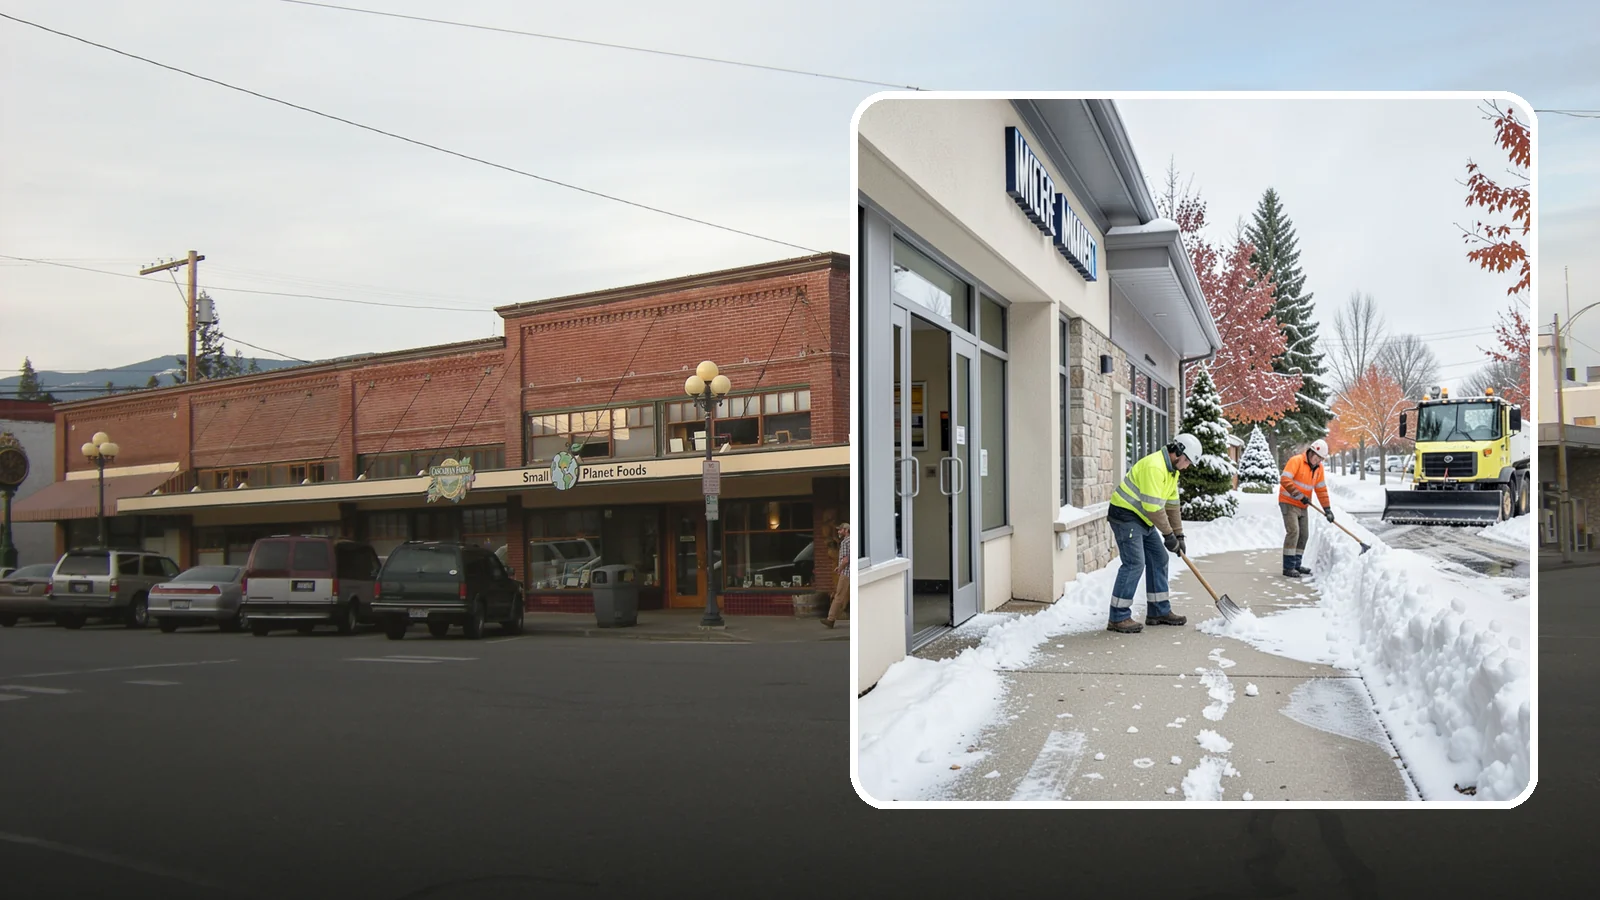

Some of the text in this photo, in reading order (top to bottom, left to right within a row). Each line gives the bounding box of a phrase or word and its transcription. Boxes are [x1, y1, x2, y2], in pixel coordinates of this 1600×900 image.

[523, 464, 647, 483] Small Planet Foods
